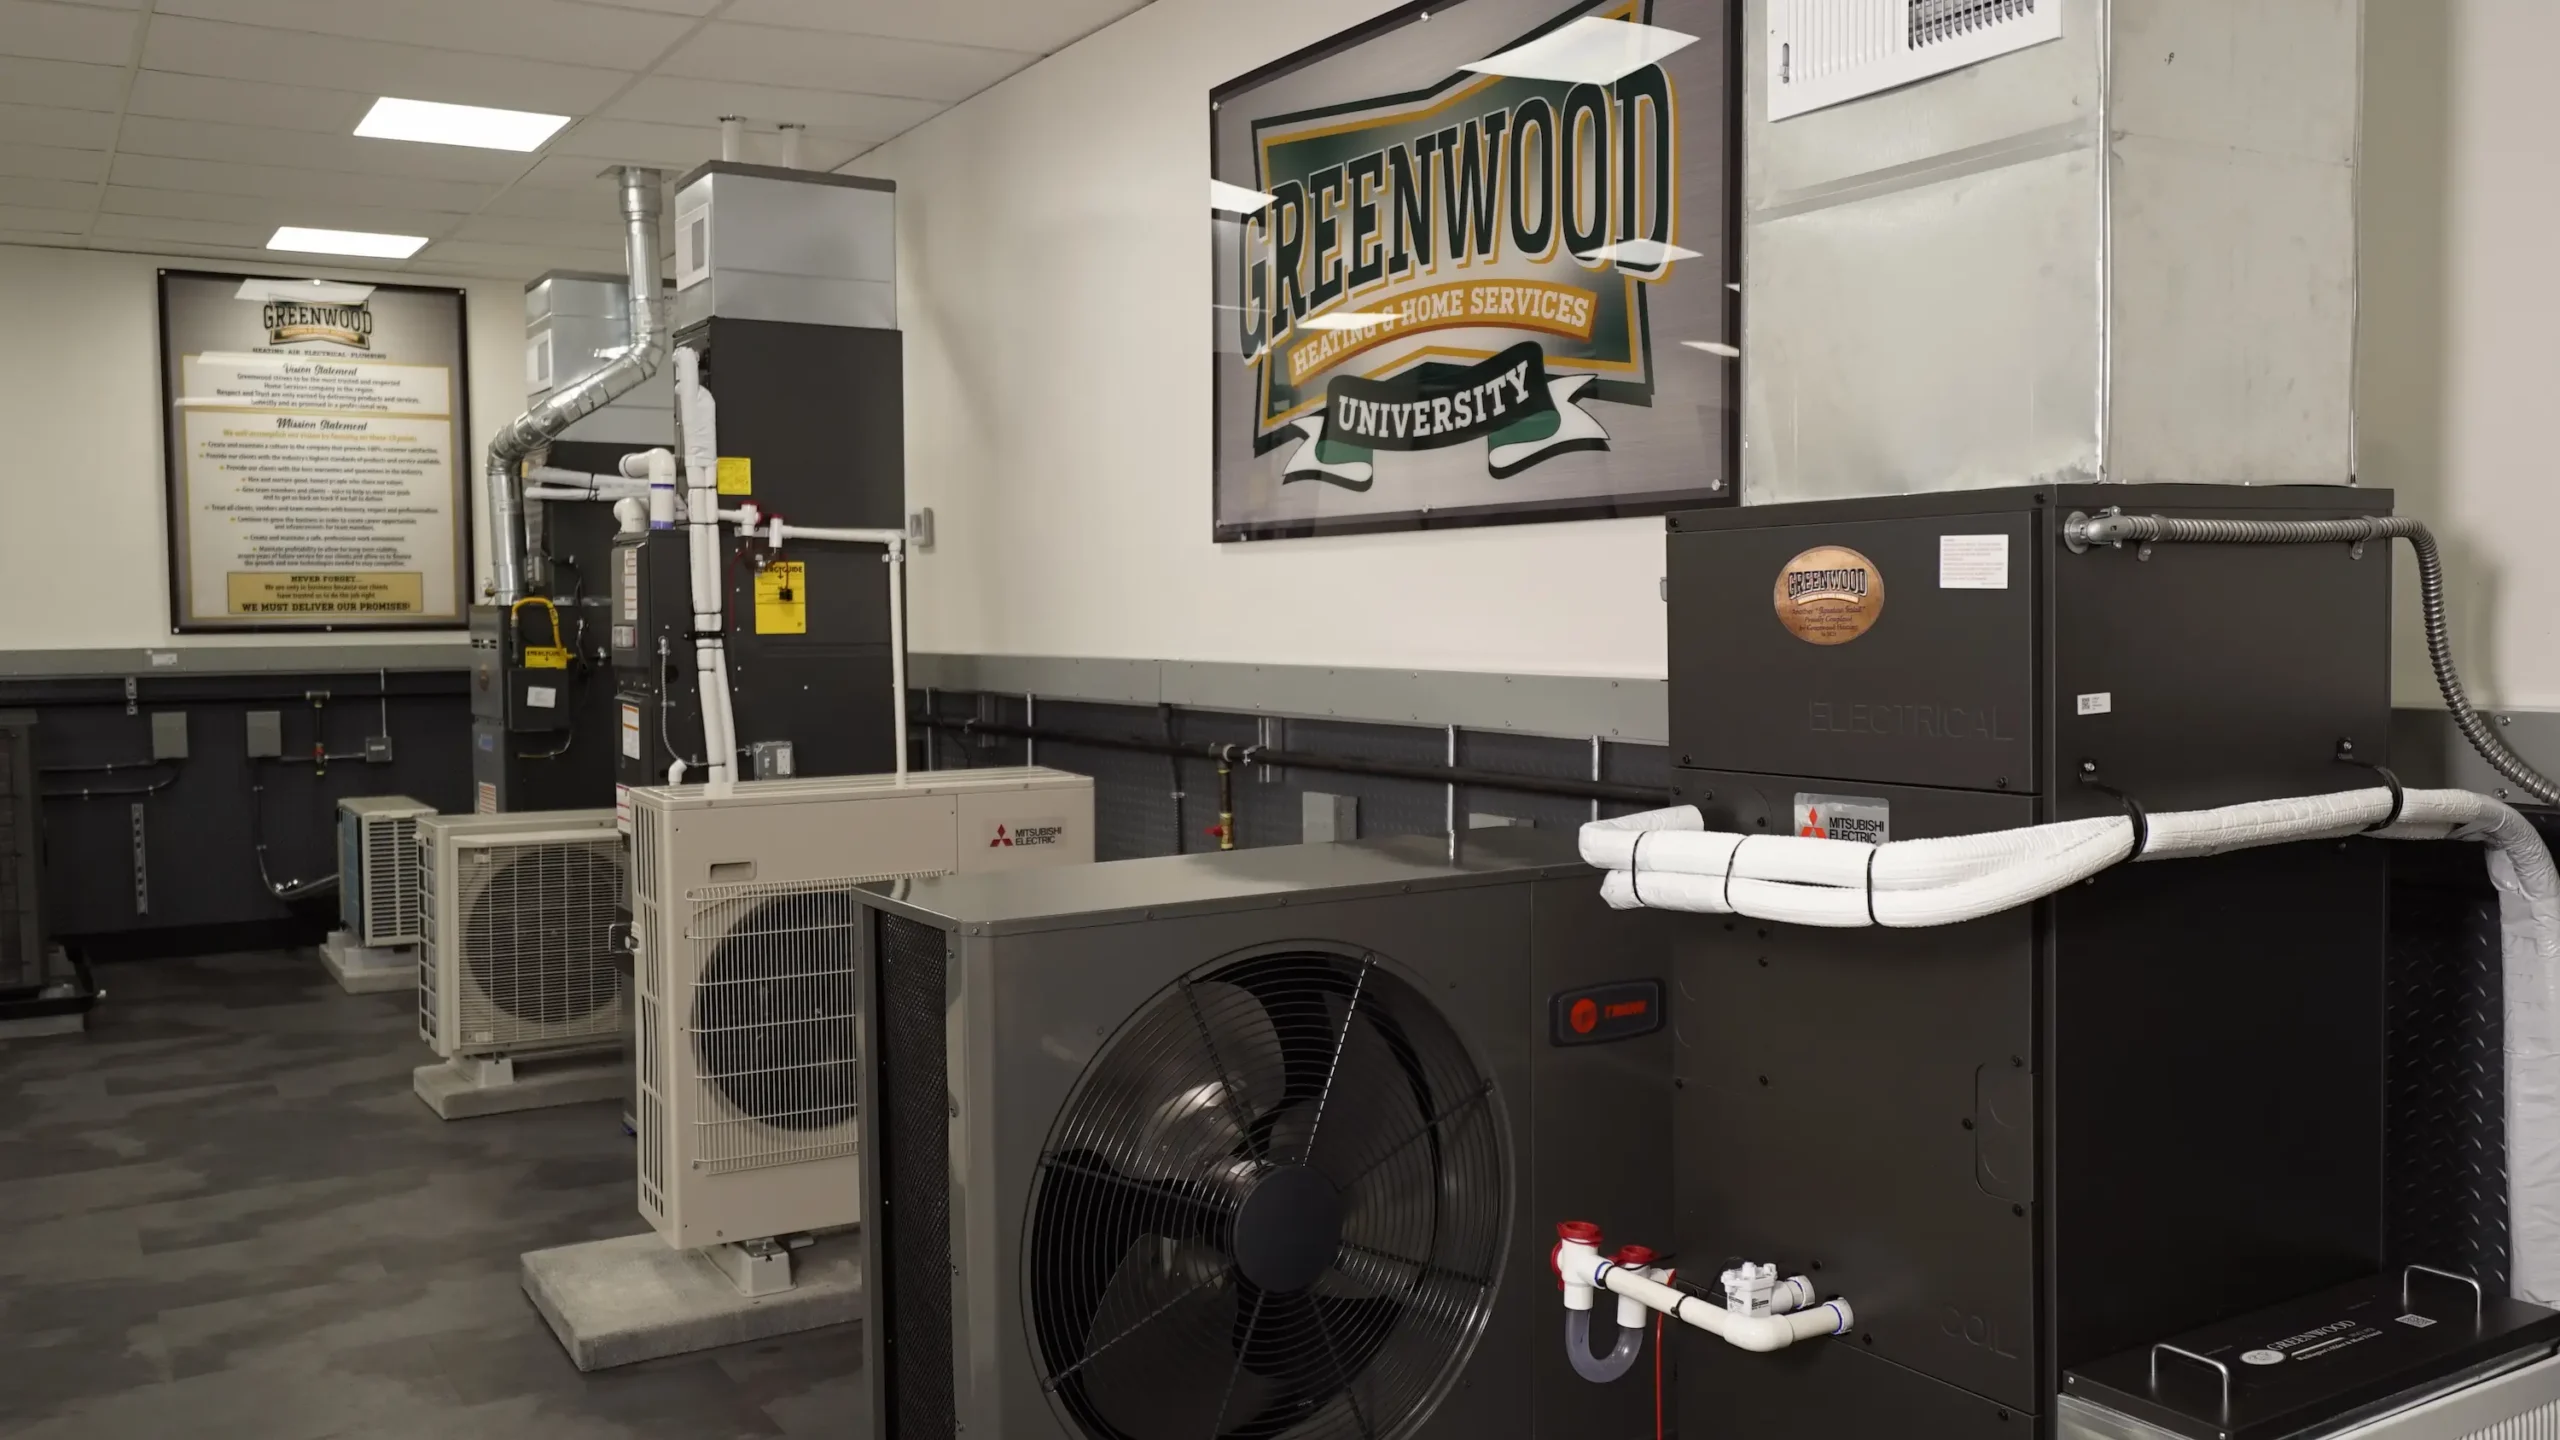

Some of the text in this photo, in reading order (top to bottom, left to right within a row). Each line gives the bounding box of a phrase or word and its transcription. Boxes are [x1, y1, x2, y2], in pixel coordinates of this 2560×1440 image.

[1239, 62, 1678, 366] GREENWOOD
[263, 304, 373, 335] GREENWOOD
[1294, 286, 1589, 377] HEATING & HOME SERVICES
[283, 362, 358, 376] Vision Statement
[1338, 360, 1530, 438] UNIVERSITY
[276, 417, 368, 431] Mission Statement
[1787, 568, 1868, 600] GREENWOOD
[242, 603, 258, 612] WE
[261, 603, 288, 612] MUST
[292, 603, 334, 612] DELIVER
[337, 603, 357, 611] OUR
[1809, 699, 2015, 741] ELECTRICAL
[1015, 826, 1062, 837] MITSUBISHI
[1015, 835, 1056, 846] ELECTRIC
[1829, 817, 1884, 833] MITSUBISHI
[1829, 829, 1876, 844] ELECTRIC
[1940, 1302, 2018, 1359] COIL
[2266, 1319, 2357, 1351] GREENWOOD
